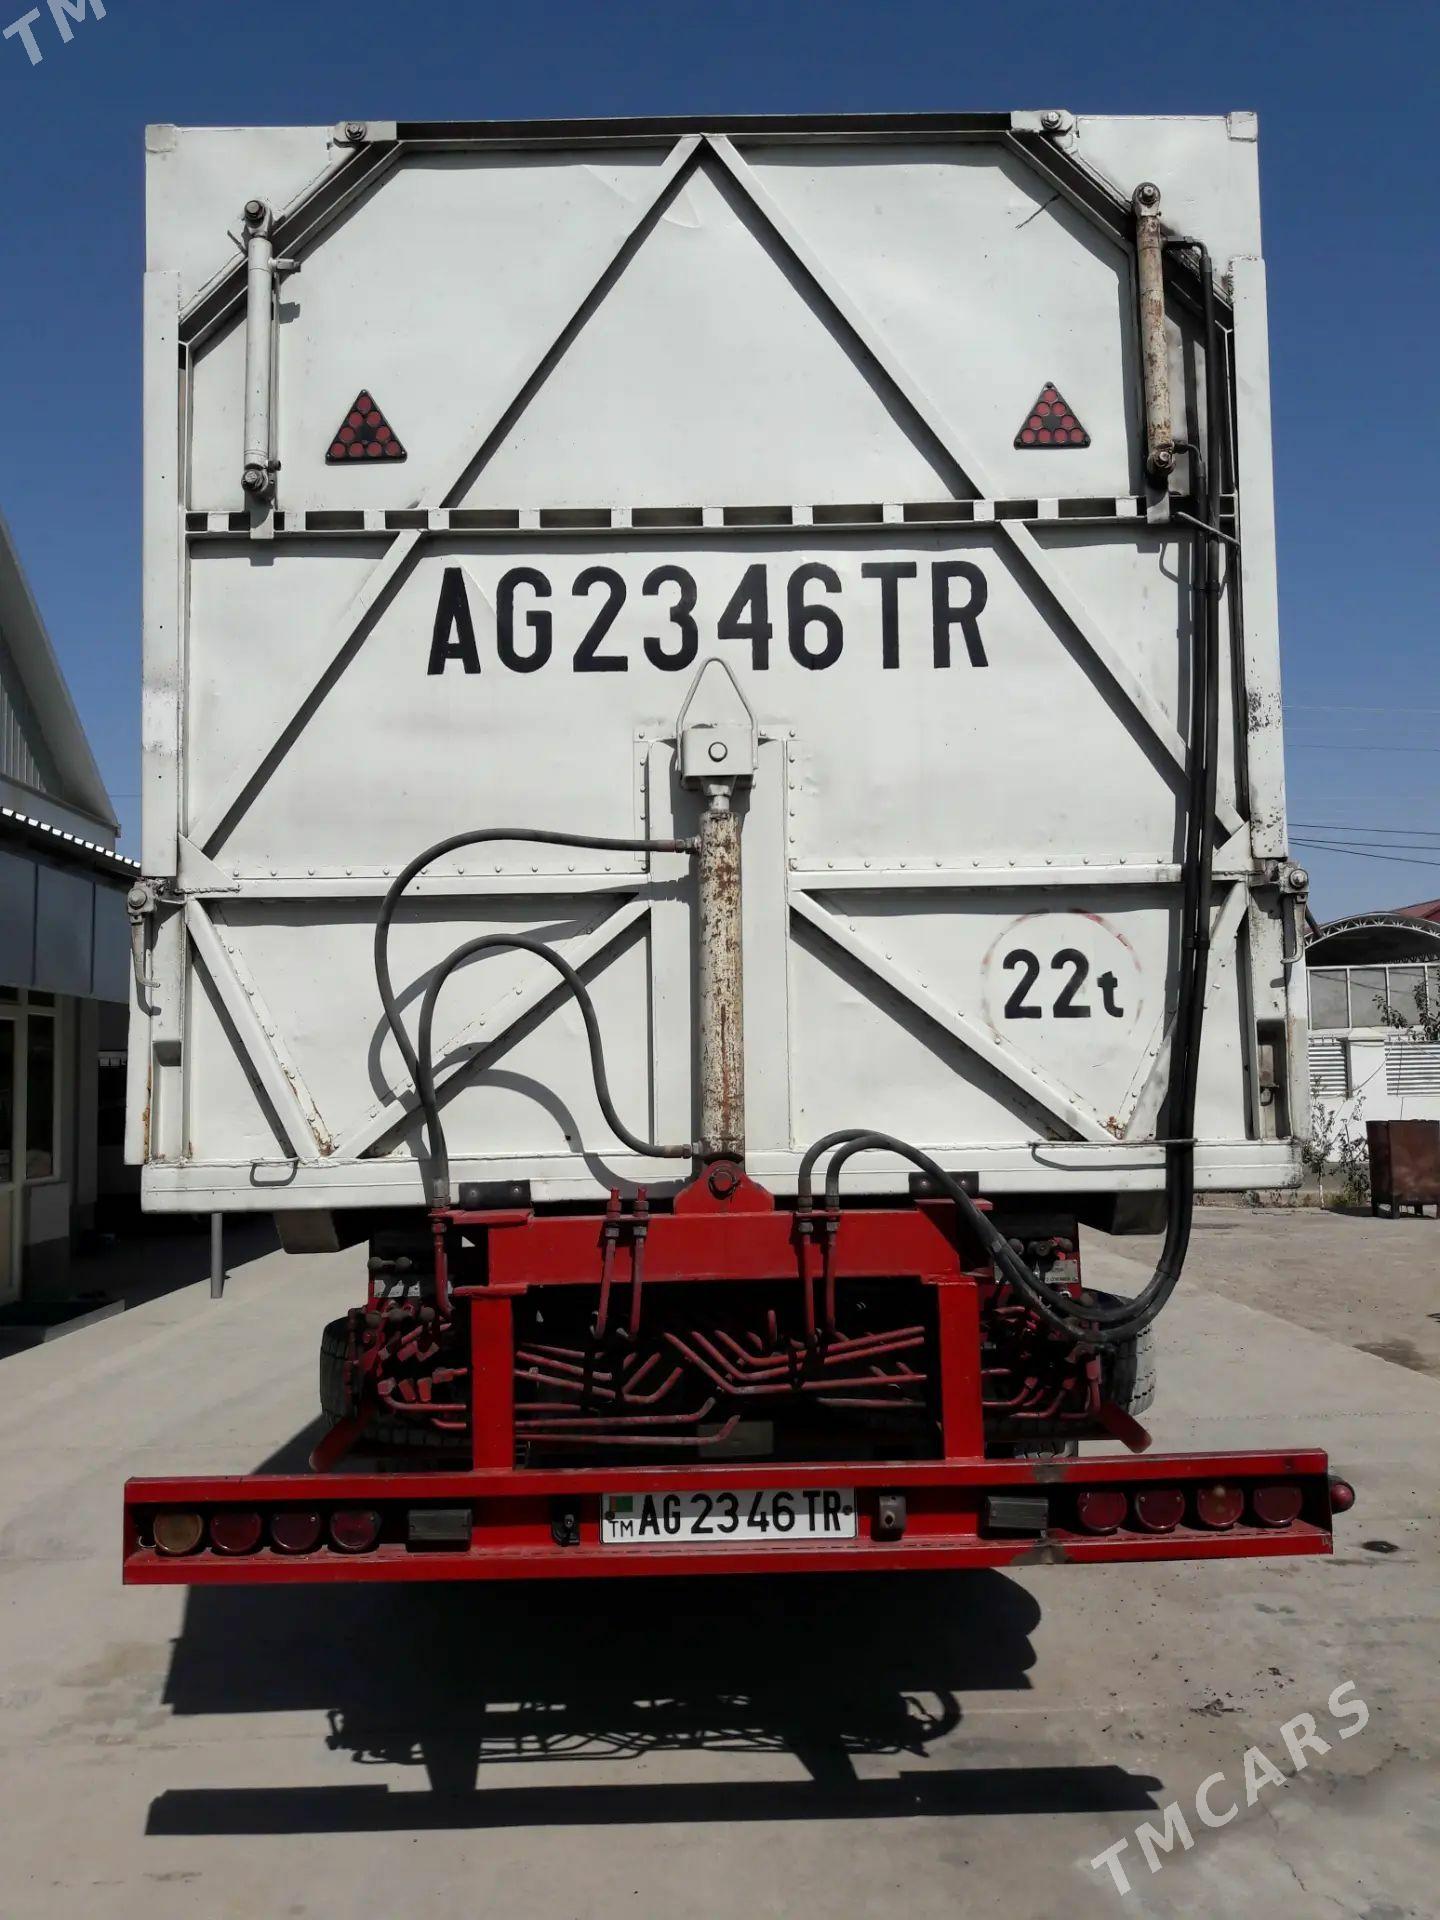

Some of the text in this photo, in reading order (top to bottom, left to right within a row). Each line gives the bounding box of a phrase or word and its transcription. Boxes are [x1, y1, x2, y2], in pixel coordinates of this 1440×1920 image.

[427, 561, 989, 675] AG2346TR
[1003, 948, 1124, 1019] 22t
[610, 1520, 634, 1537] TM
